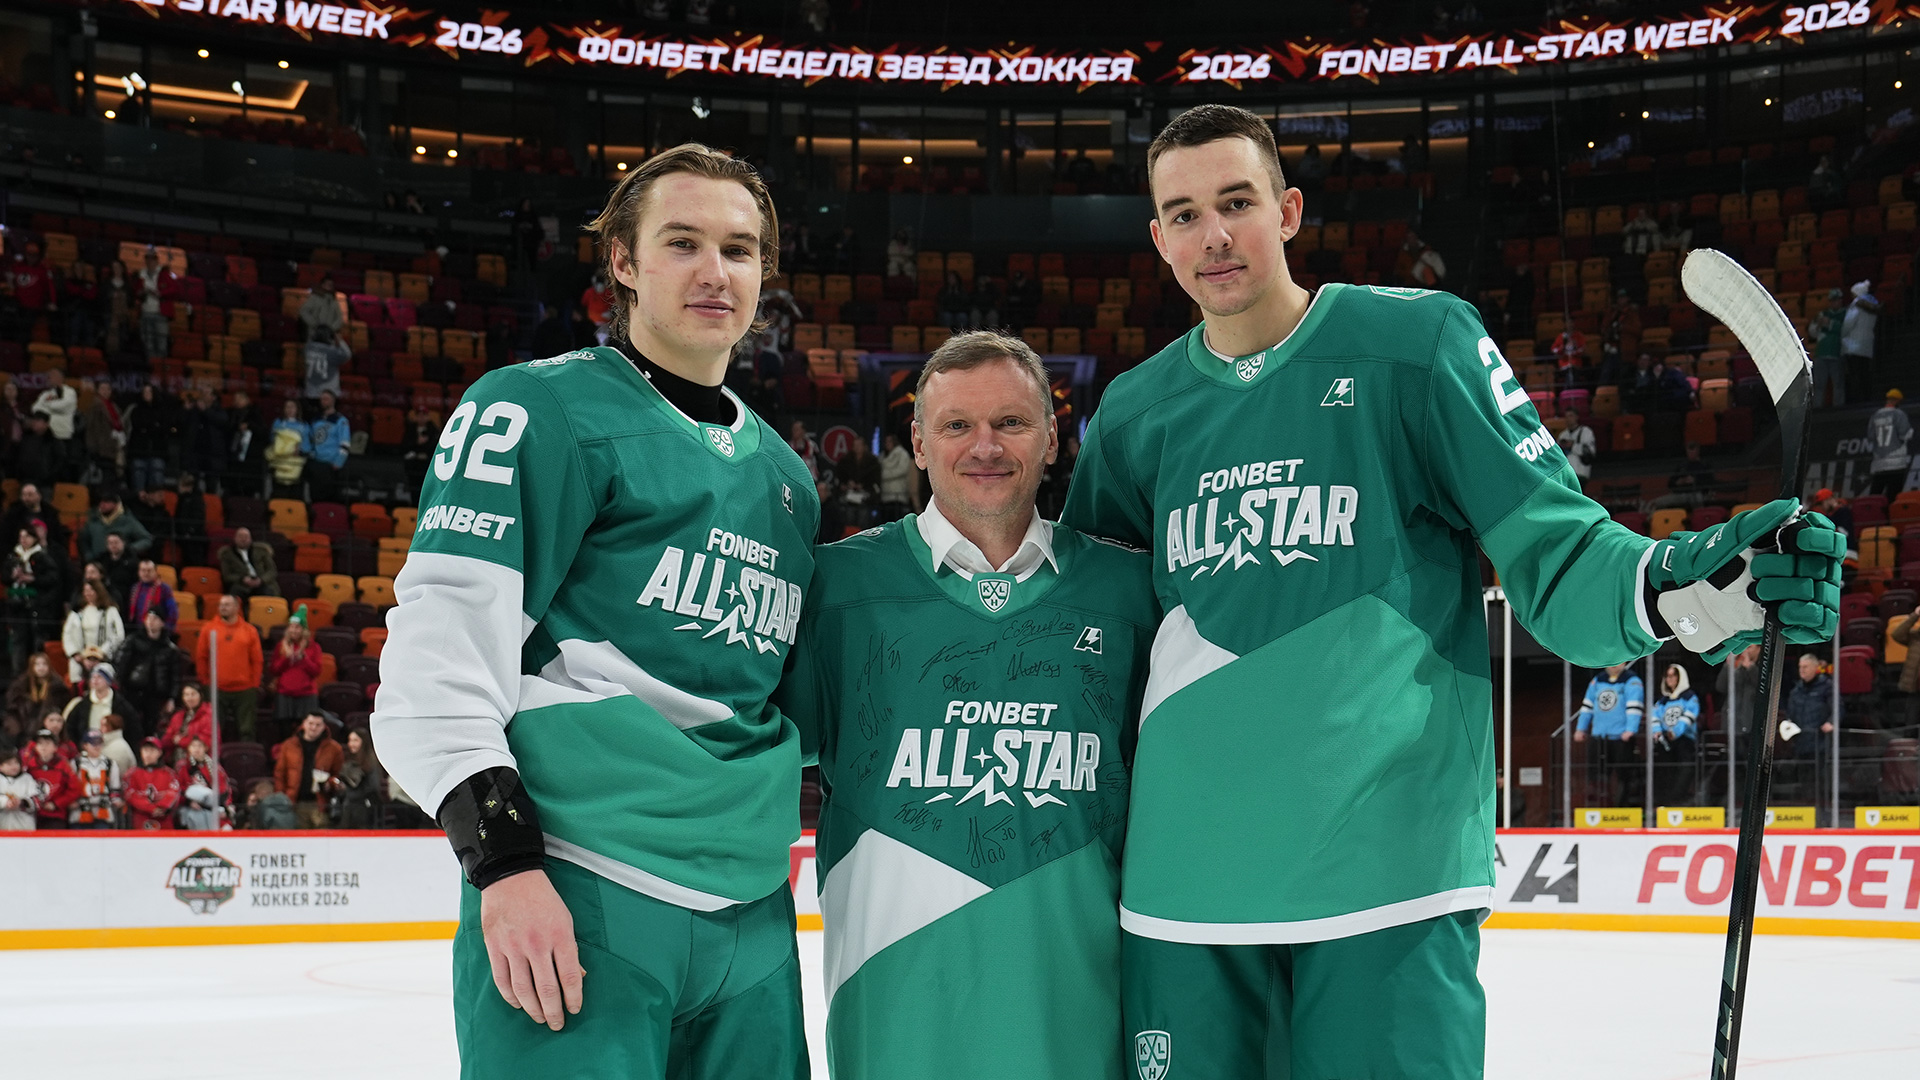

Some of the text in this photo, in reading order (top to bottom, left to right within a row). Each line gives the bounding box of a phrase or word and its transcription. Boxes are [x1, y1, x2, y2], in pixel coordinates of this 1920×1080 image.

[285, 0, 392, 39] WEEK
[1780, 0, 1872, 34] 2026
[435, 20, 523, 55] 2026
[1318, 16, 1737, 76] FONBET ALL-STAR WEEK
[578, 36, 1134, 84] ФОНБЕТ НЕДЕЛЯ ЗВЕЗД ХОККЕЯ
[1188, 53, 1273, 81] 2026
[434, 401, 529, 485] 92
[1836, 438, 1874, 455] FON
[1198, 459, 1304, 497] FONBET
[418, 505, 516, 540] FONBET
[1167, 485, 1358, 573] ALL STAR
[707, 527, 779, 571] FONBET
[636, 545, 802, 645] ALL STAR
[944, 700, 1058, 726] FONBET
[886, 728, 974, 789] ALL
[993, 729, 1100, 791] STAR
[169, 867, 239, 888] ALL STAR
[250, 854, 307, 868] FONBET
[251, 872, 359, 888] НЕДЕЛЯ ЗВЕЗД
[251, 892, 349, 906] ХОККЕЯ 2026
